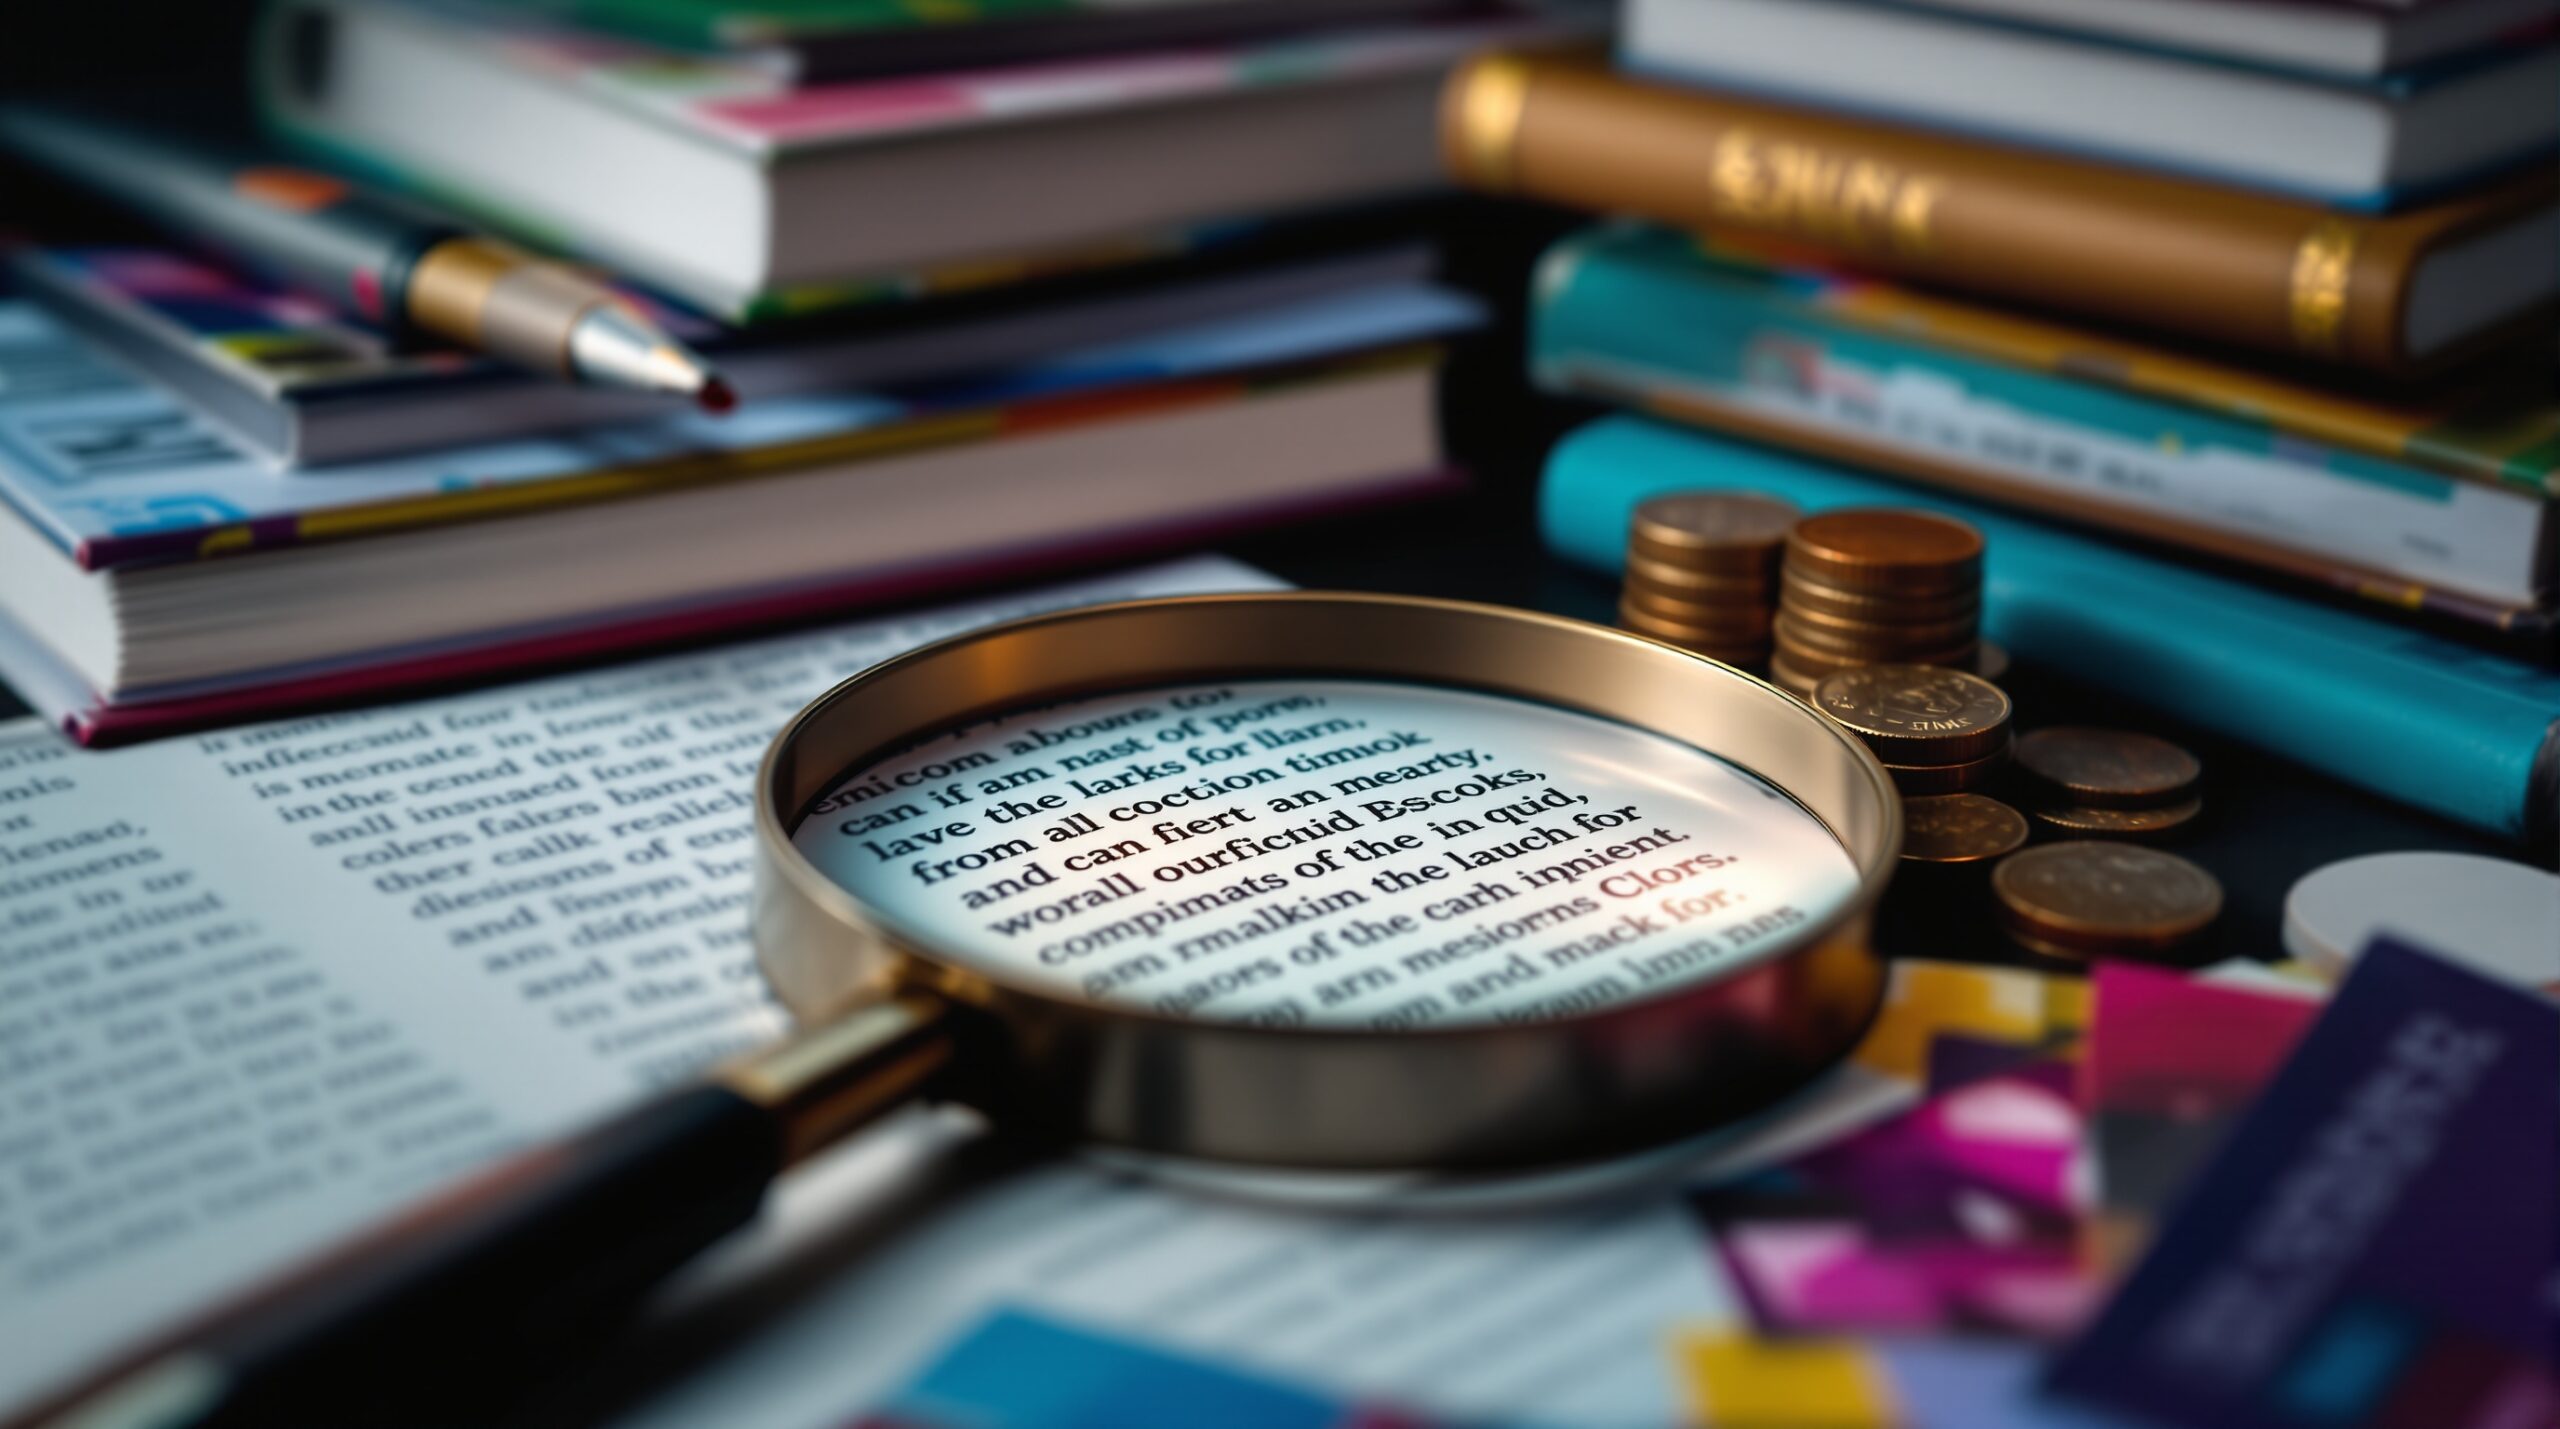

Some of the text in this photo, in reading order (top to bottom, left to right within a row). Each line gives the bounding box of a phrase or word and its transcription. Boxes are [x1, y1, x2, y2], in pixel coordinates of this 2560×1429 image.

[325, 788, 401, 813] the
[838, 802, 929, 837] can
[927, 782, 975, 809] if
[977, 765, 1055, 796] am
[1056, 736, 1155, 773] nast
[1156, 717, 1206, 743] of
[860, 820, 977, 863] lave
[983, 793, 1068, 825] the
[1065, 759, 1188, 800] larks
[1186, 739, 1255, 767] for
[624, 836, 673, 865] of
[909, 836, 1039, 887] from
[1042, 811, 1105, 843] all
[1108, 765, 1287, 822] coction
[960, 861, 1062, 910] and
[1063, 838, 1152, 872] can
[1151, 805, 1257, 846] fiert
[1266, 787, 1332, 814] an
[1370, 862, 1451, 894] the
[1442, 826, 1581, 872] lauch
[1571, 804, 1642, 834] for
[984, 872, 1147, 939] worall
[1037, 786, 1590, 966] compimats of the in quid,
[1598, 851, 1740, 899] Clors.
[1289, 928, 1342, 967] of
[1337, 912, 1421, 948] the
[1421, 880, 1521, 922] carh
[1445, 951, 1544, 1006] and
[1543, 913, 1670, 970] mack
